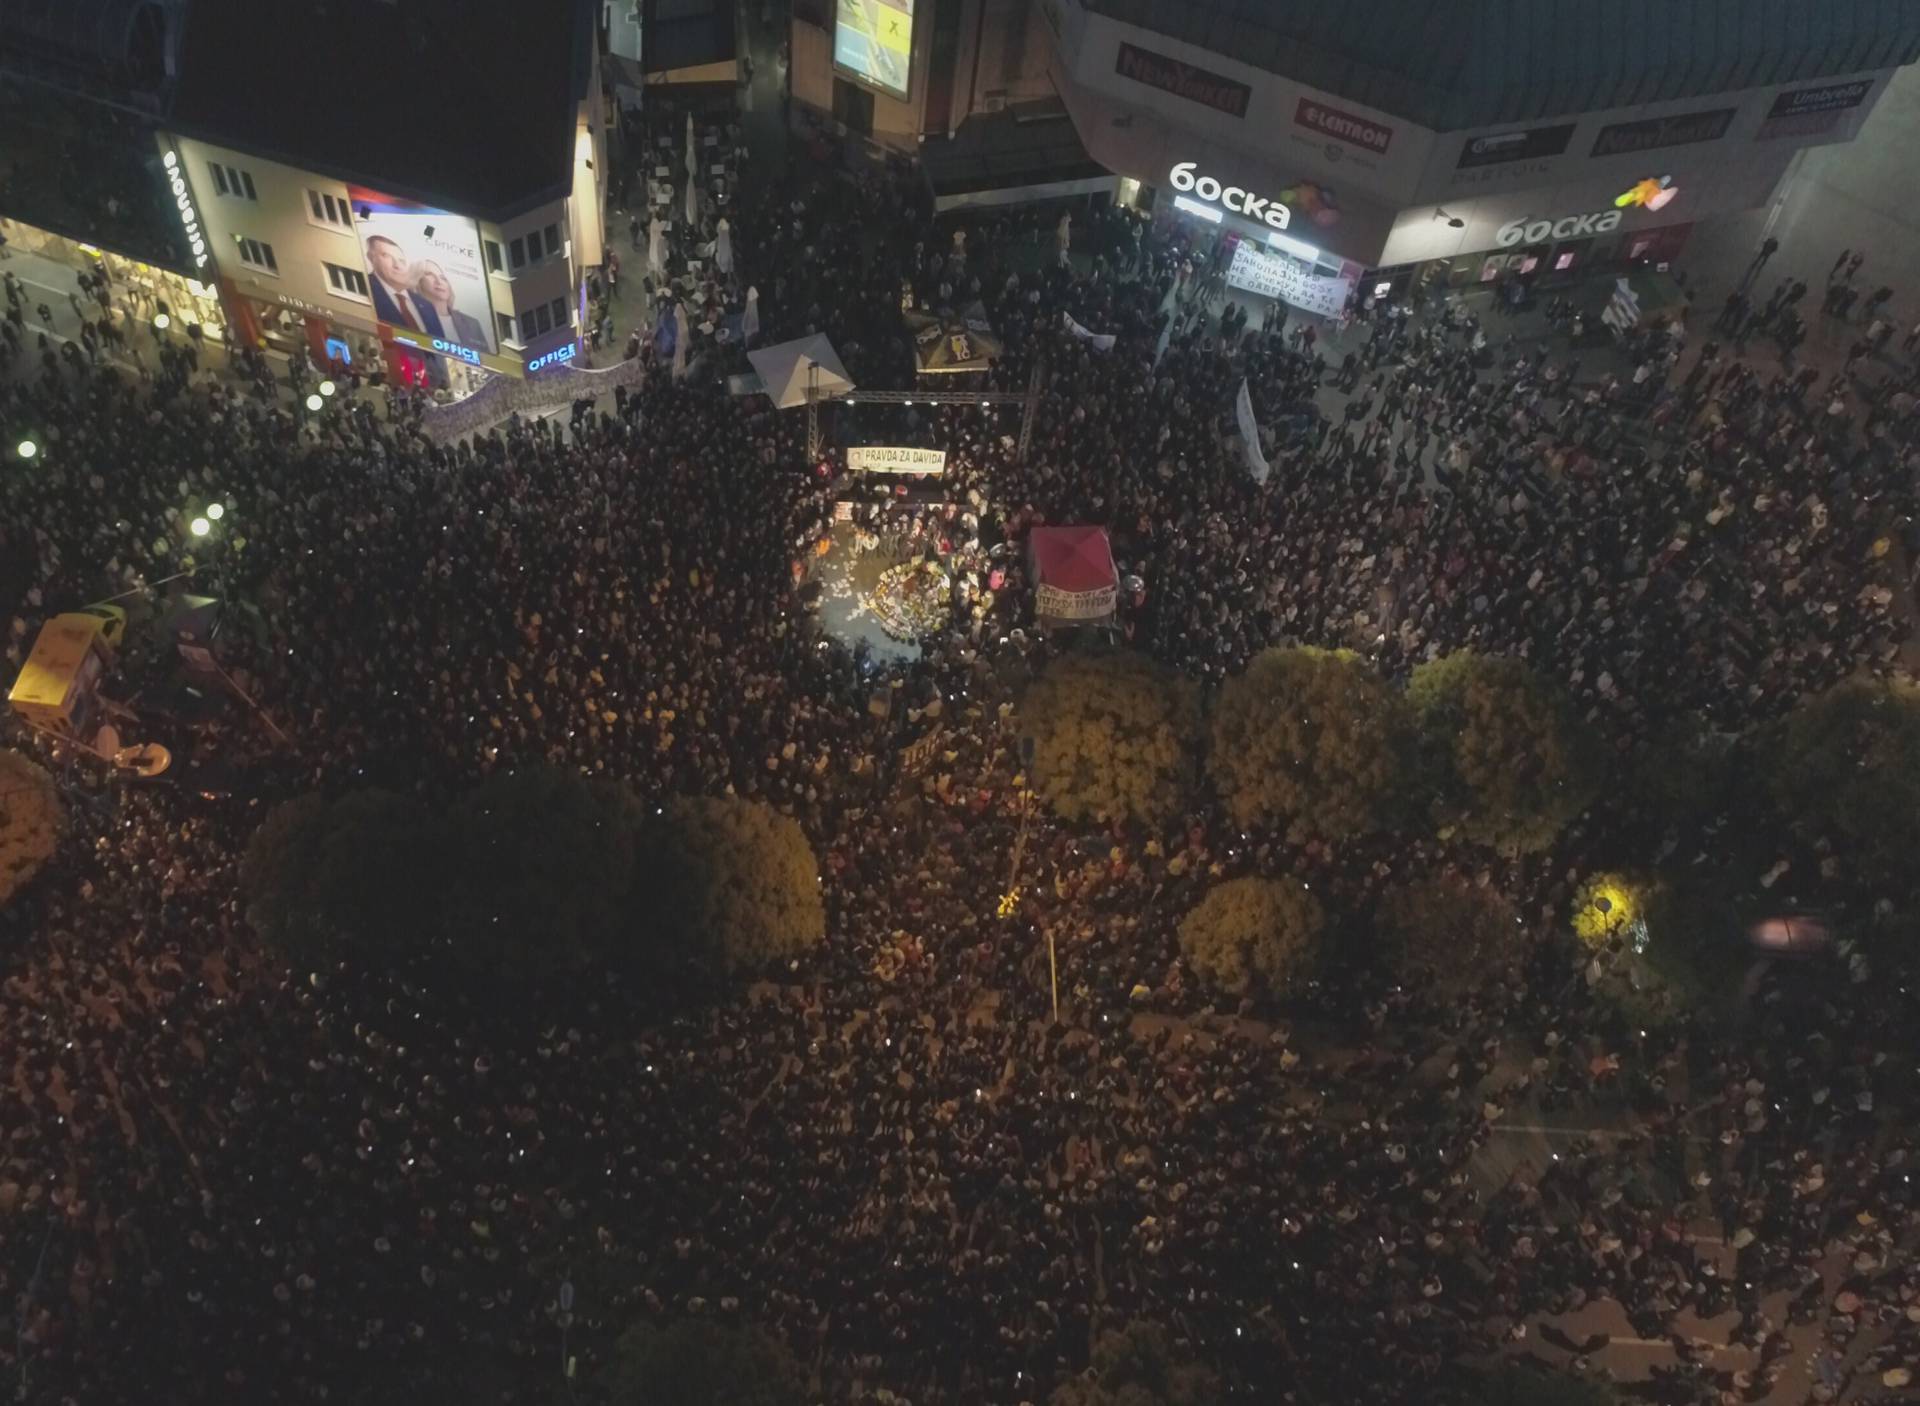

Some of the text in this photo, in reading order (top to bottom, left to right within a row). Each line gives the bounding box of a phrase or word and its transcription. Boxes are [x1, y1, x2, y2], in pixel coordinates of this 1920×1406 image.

[1170, 162, 1291, 230] боска
[1496, 209, 1622, 247] боска
[432, 339, 480, 360] OFFICE
[528, 343, 576, 371] OFFICE
[865, 450, 943, 464] PRAVDA ZA DAVIDA
